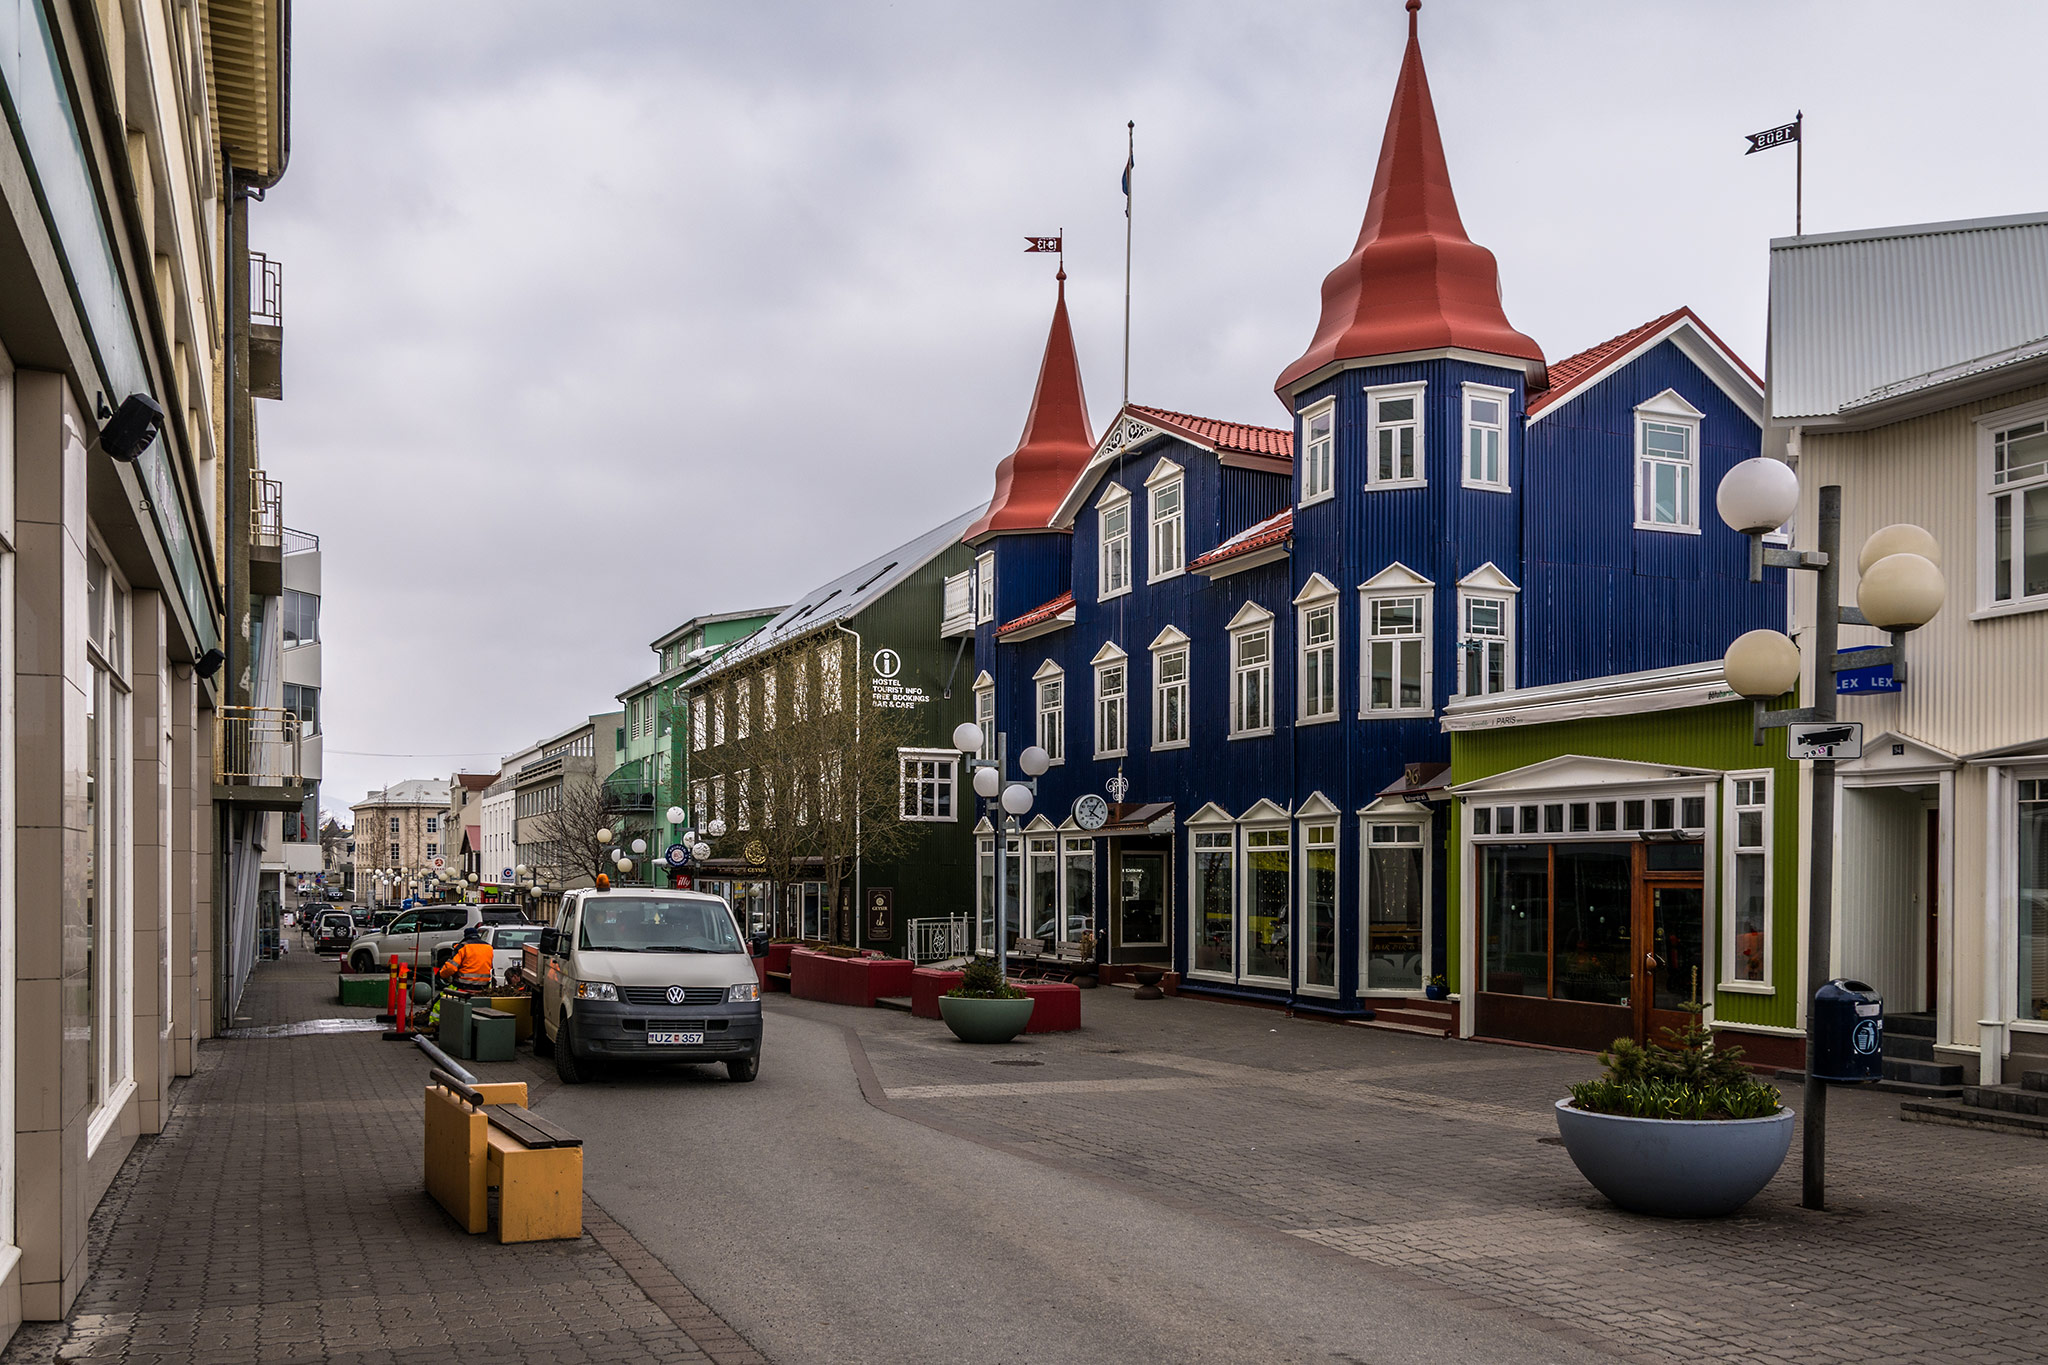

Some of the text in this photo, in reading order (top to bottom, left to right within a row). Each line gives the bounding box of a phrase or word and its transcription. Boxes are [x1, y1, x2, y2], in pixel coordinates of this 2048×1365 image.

[872, 678, 901, 686] HOSTEL
[1871, 677, 1893, 687] LEX
[872, 686, 903, 694] TOURIST
[892, 694, 930, 702] BOOKINGS
[1405, 768, 1419, 785] 96
[677, 876, 691, 887] illy
[655, 1034, 702, 1042] UZ 357
